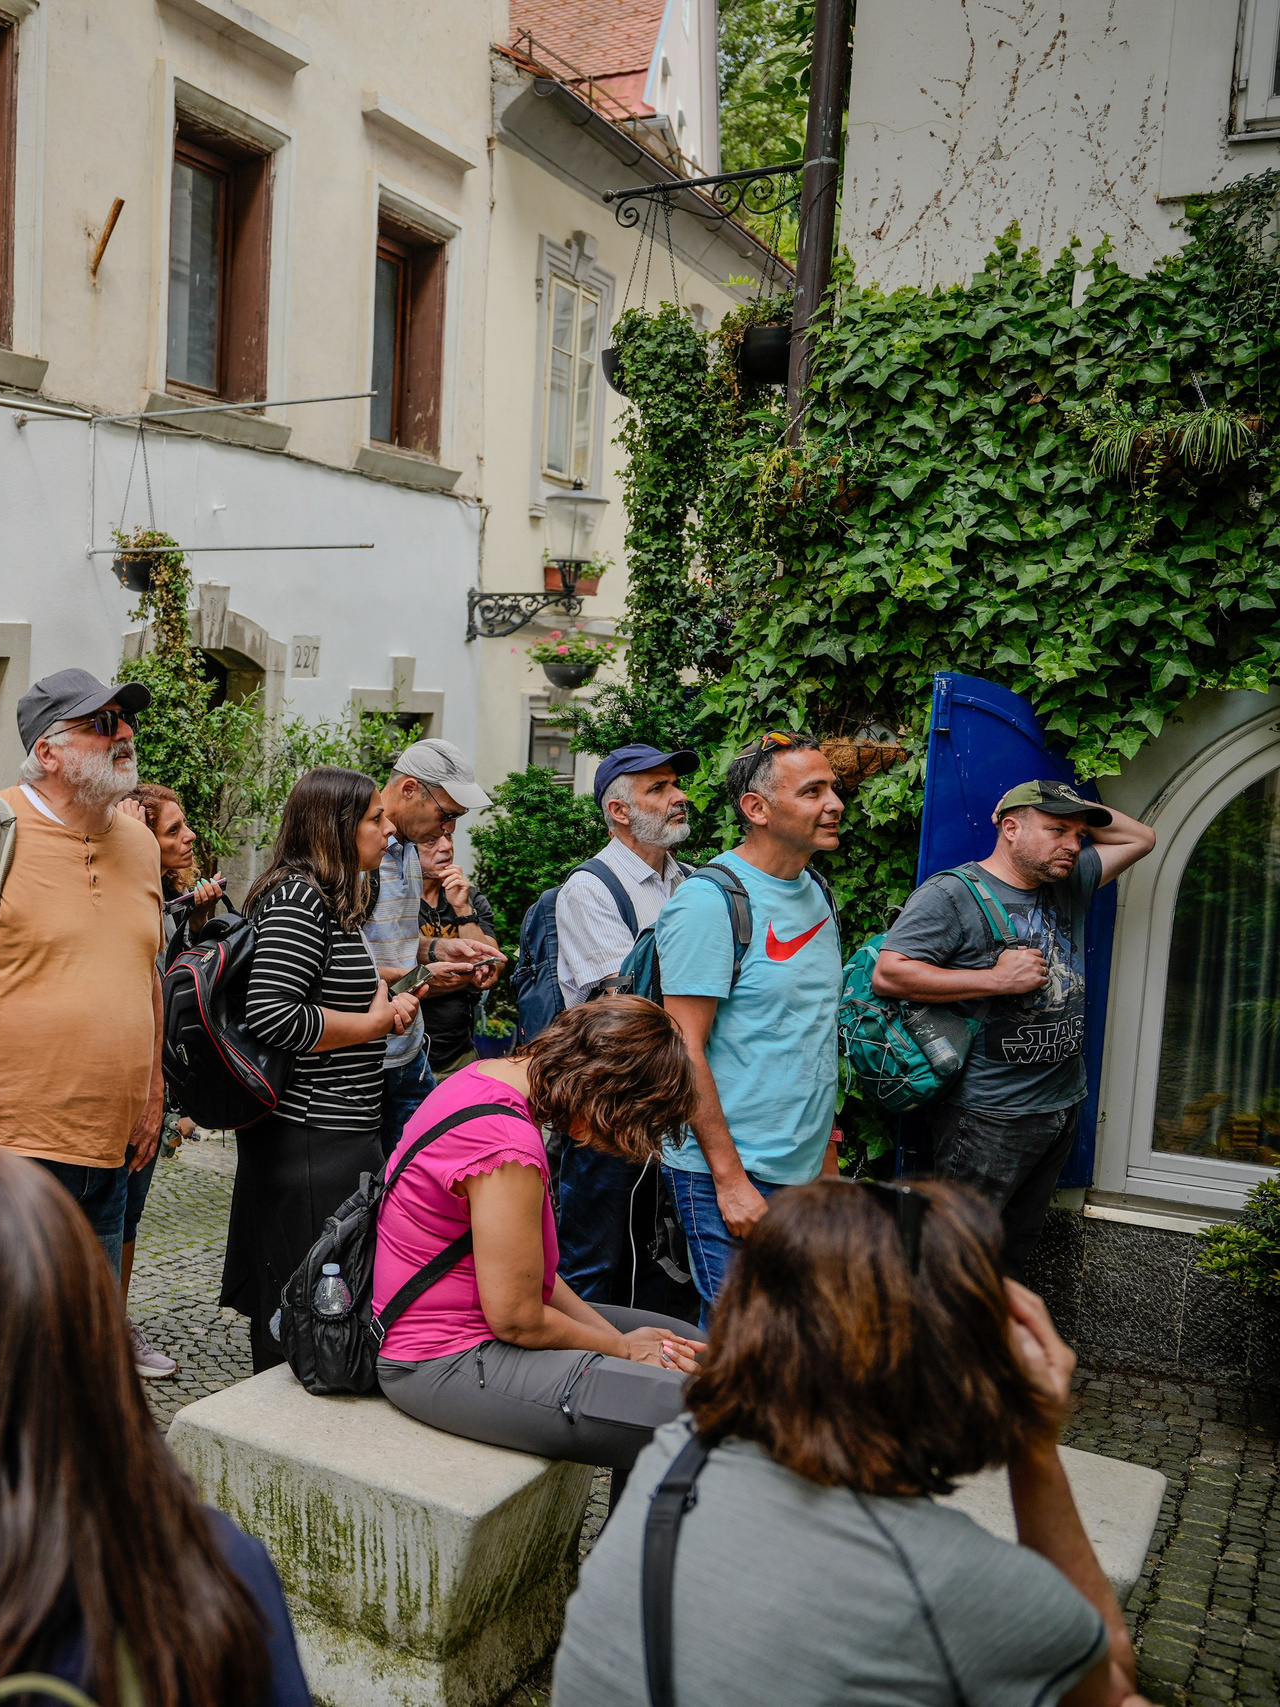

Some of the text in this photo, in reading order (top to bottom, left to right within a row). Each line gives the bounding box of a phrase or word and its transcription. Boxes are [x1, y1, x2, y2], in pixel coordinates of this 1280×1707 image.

[295, 645, 319, 677] 227
[1002, 1015, 1084, 1046] STAR
[1002, 1038, 1084, 1064] WARS
